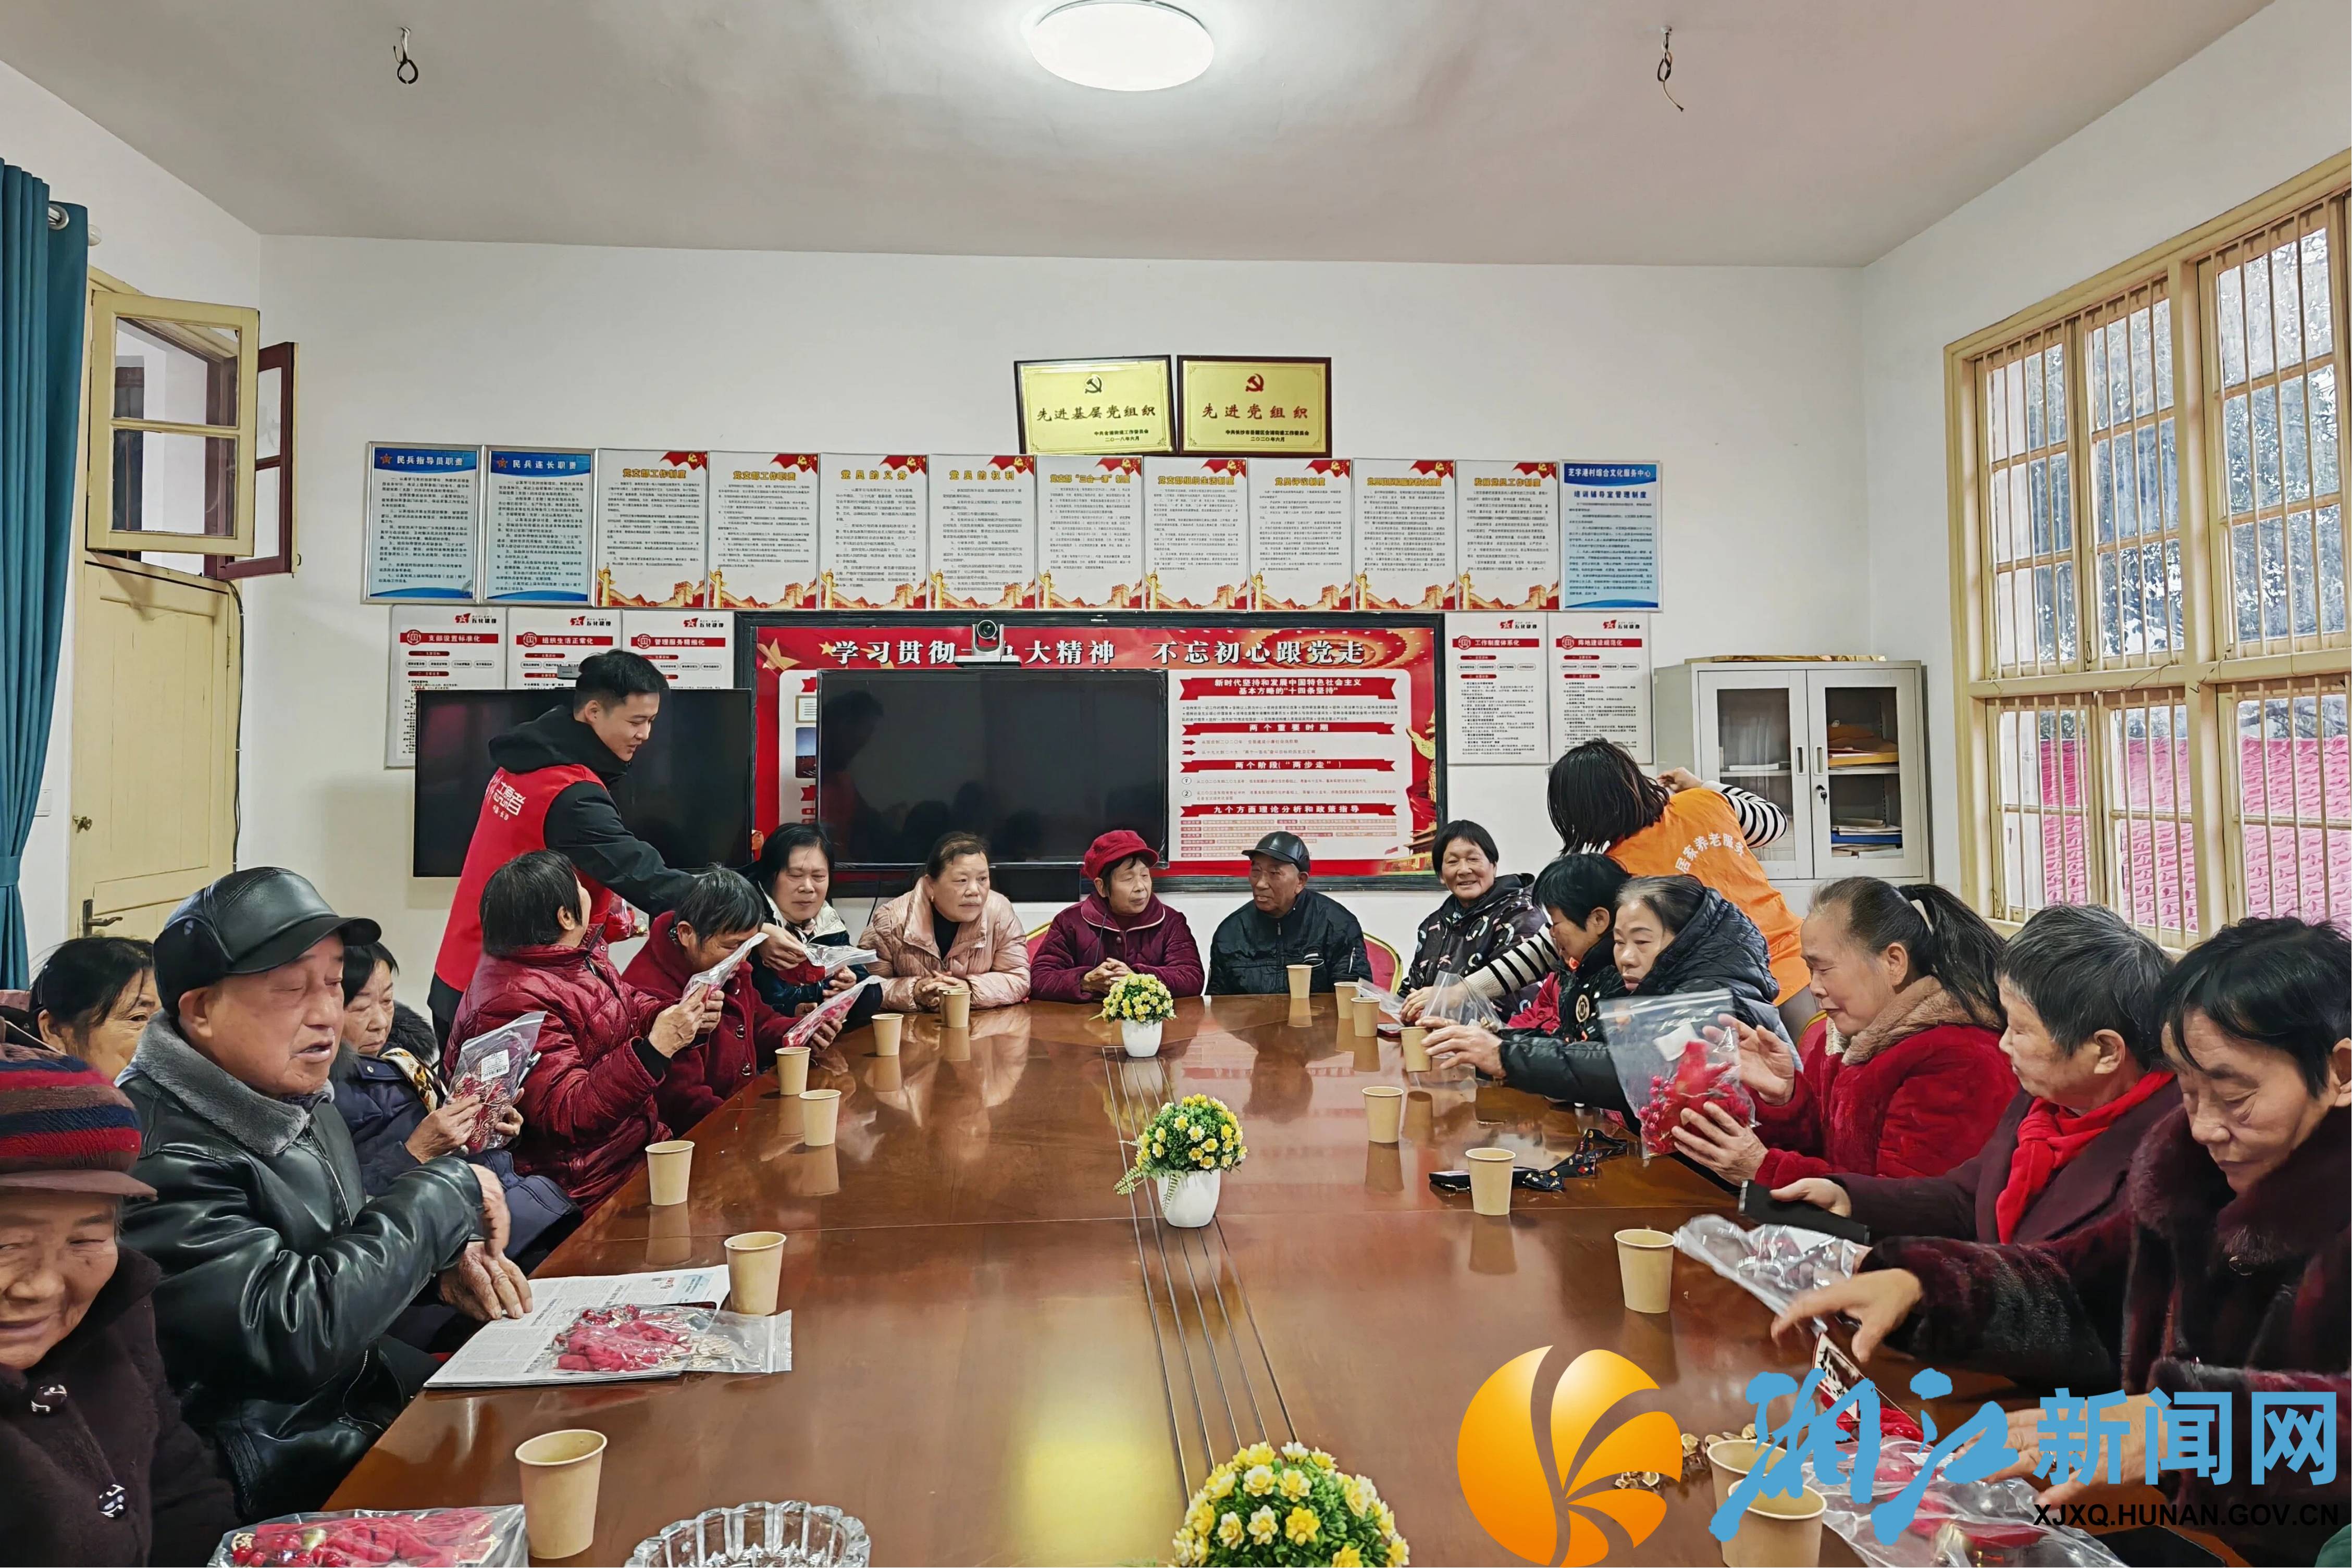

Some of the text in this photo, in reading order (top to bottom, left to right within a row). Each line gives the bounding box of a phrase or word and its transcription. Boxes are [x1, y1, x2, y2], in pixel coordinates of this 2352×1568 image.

[1036, 404, 1156, 422] 先进基层党组织
[1202, 402, 1309, 420] 先进党组织
[397, 455, 464, 466] 民兵指导员职责
[513, 459, 577, 470] 民兵连长职责
[623, 468, 687, 479] 党支部工作制度
[733, 470, 797, 481] 党支部工作职责
[840, 469, 908, 480] 党员的义务
[949, 470, 1015, 481] 党员的权利
[1157, 476, 1235, 486] 党支部组织生活制度
[1274, 477, 1326, 487] 党员评议制度
[1474, 478, 1542, 487] 发展党员工作制度
[1574, 491, 1648, 499] 培训辅导室管理制度
[541, 637, 594, 645] 组织生活正常化
[654, 638, 705, 646] 管理服务精细化
[831, 640, 1366, 665] 学习贯彻大精神 不忘初心跟党走
[1215, 678, 1361, 687] 新时代坚持和发展中国特色社会主义
[1249, 724, 1329, 732] 两个重要时期
[1214, 805, 1360, 814] 九个方面理论分析和政策指导
[1674, 832, 1746, 874] 居家养老服务
